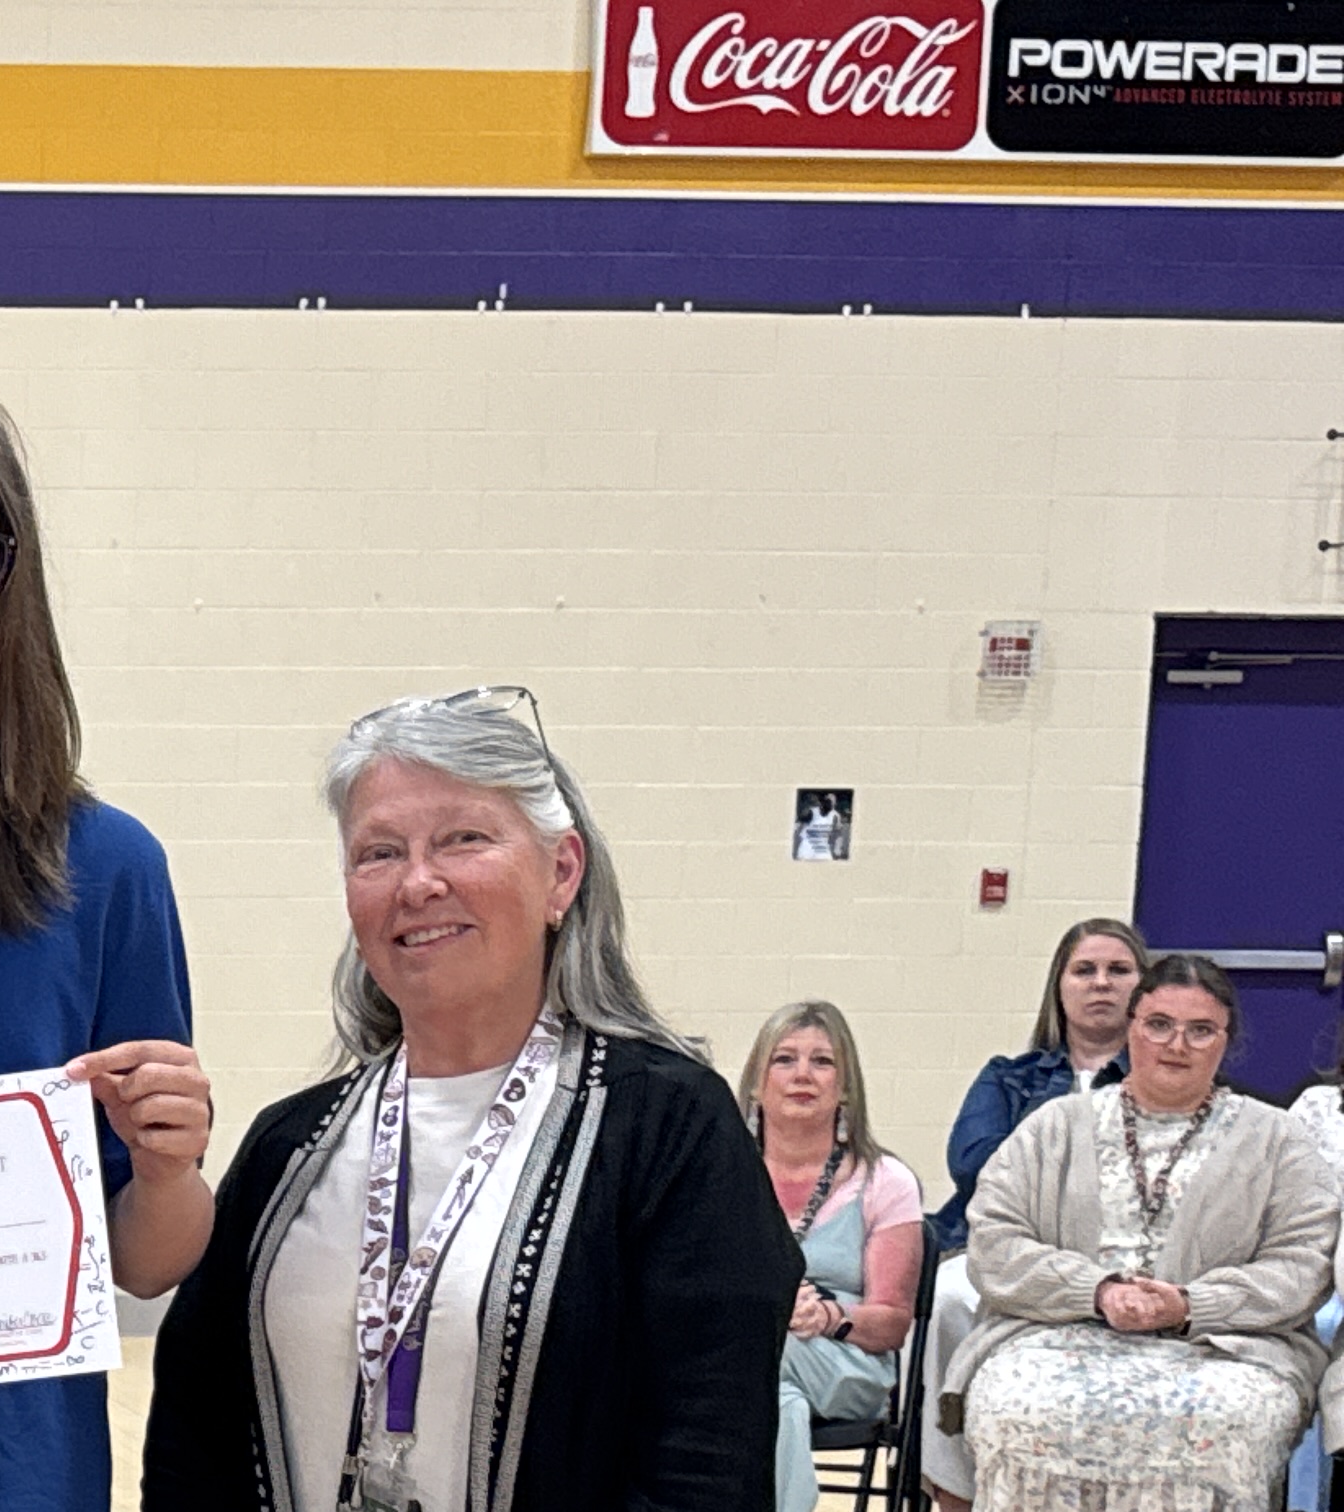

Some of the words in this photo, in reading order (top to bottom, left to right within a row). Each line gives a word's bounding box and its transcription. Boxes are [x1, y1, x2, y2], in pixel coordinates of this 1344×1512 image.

[669, 12, 977, 117] Coca-Cola
[1007, 37, 1344, 84] POWERADE
[1114, 87, 1185, 104] ADVANCED
[1190, 89, 1281, 106] ELECTROLYTE
[1288, 91, 1343, 107] SYSTEM
